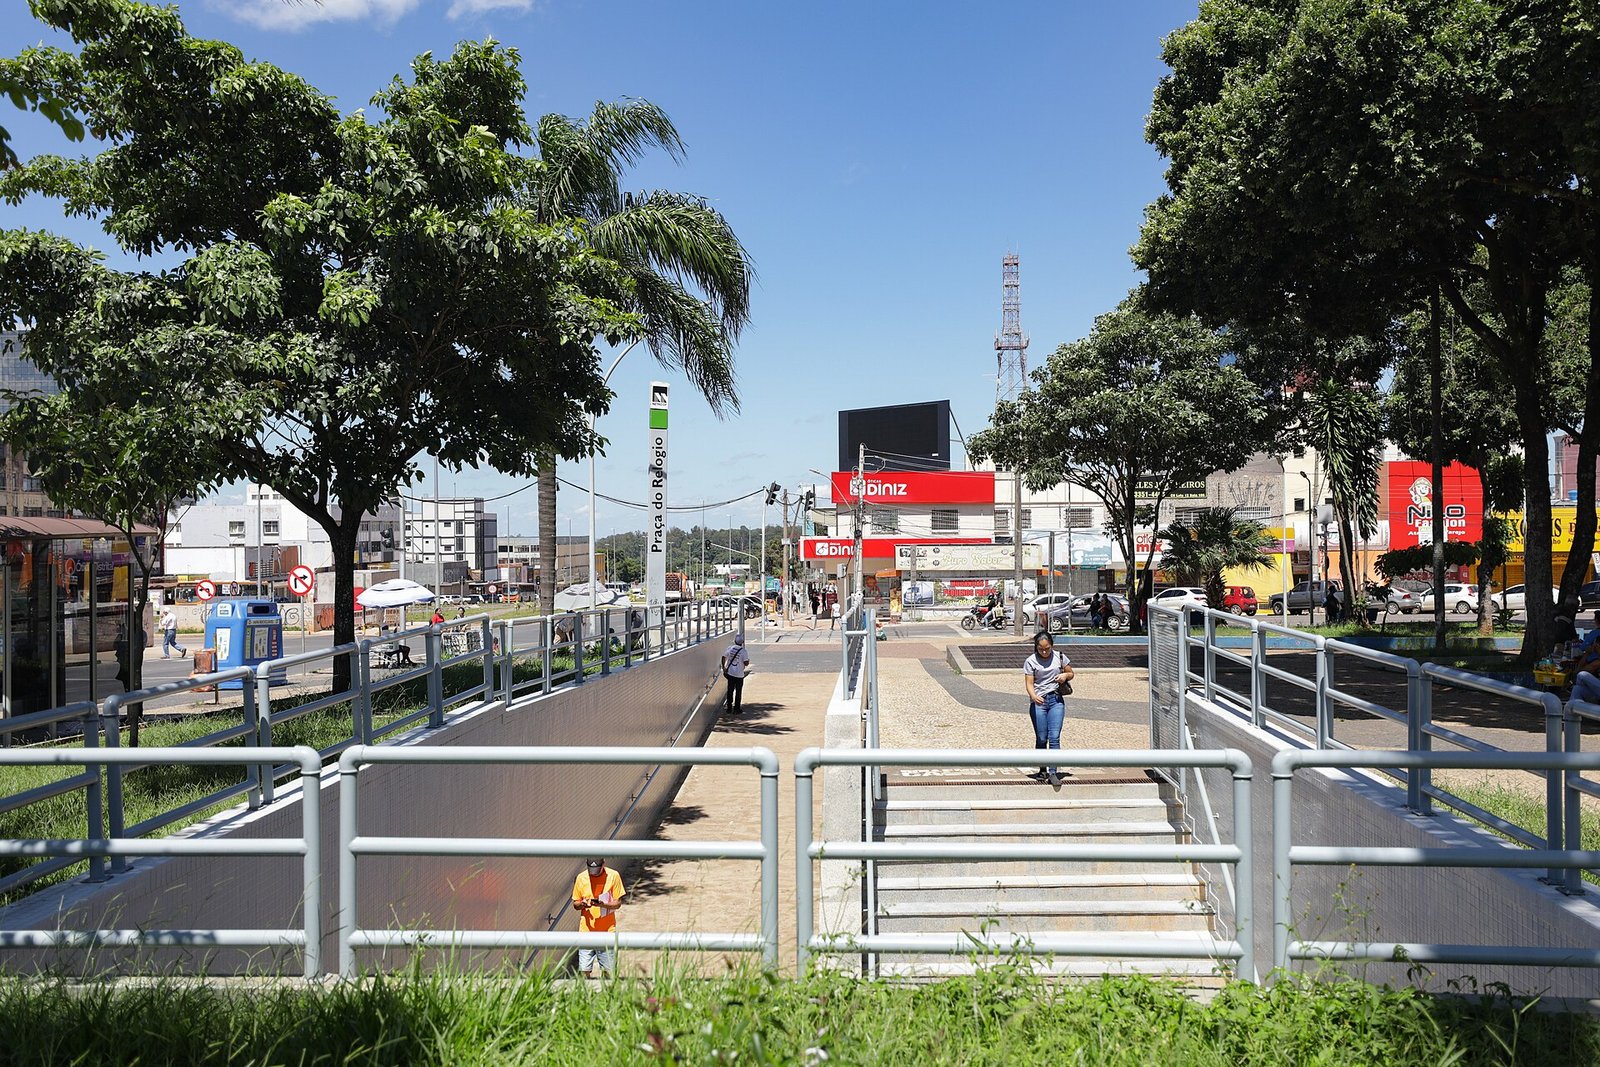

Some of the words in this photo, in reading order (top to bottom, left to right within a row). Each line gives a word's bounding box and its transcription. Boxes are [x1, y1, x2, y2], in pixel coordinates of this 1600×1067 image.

[652, 436, 667, 489] Relogio
[867, 483, 908, 496] DINIZ
[651, 492, 663, 510] do
[651, 514, 665, 553] Praça
[829, 545, 854, 556] DINI
[971, 553, 1003, 566] Sabor
